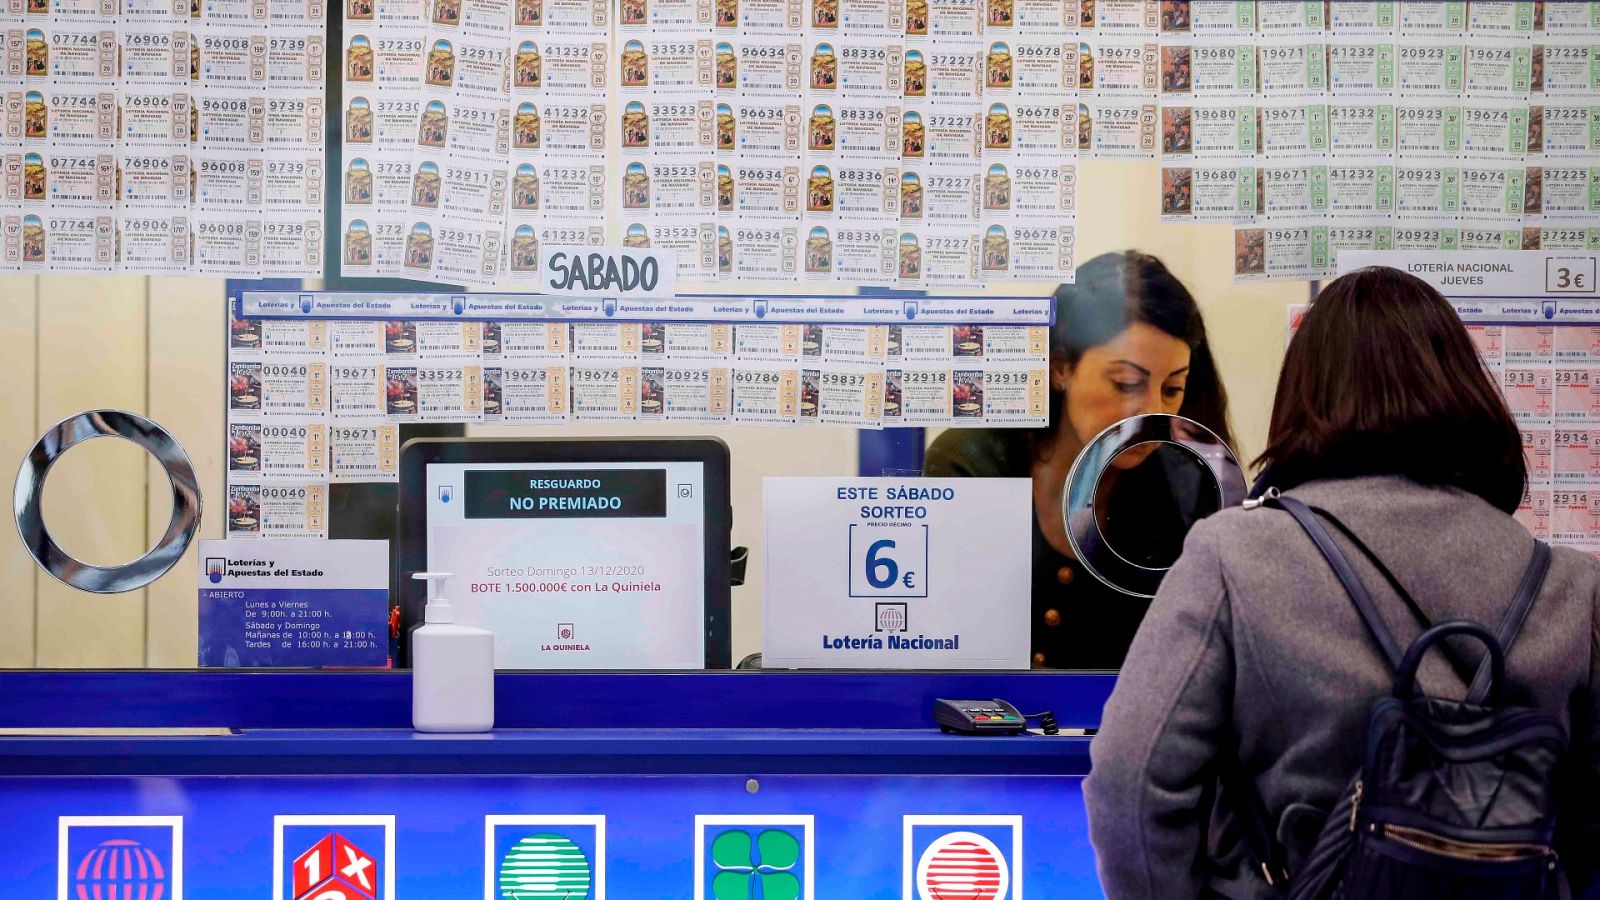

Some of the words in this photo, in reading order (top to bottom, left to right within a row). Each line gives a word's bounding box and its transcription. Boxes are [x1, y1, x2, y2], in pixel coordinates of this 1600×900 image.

[52, 34, 98, 46] 07744
[124, 34, 170, 46] 76906
[204, 38, 249, 50] 96008
[378, 40, 422, 50] 37230
[460, 46, 503, 59] 32911
[545, 46, 589, 57] 41232
[652, 44, 695, 54] 33523
[742, 47, 785, 58] 96634
[842, 48, 886, 58] 88336
[1018, 46, 1061, 56] 96678
[1098, 46, 1140, 58] 19679
[1194, 48, 1236, 59] 19680
[1262, 48, 1304, 58] 19671
[1331, 46, 1375, 58] 41232
[1400, 48, 1444, 58] 20923
[1469, 49, 1512, 60] 19674
[1545, 48, 1588, 58] 37225
[931, 55, 974, 66] 37227
[1096, 108, 1139, 119] 19679
[50, 158, 96, 168] 07744
[124, 158, 168, 168] 76906
[201, 162, 246, 172] 96008
[446, 168, 489, 182] 32911
[542, 168, 586, 180] 41232
[654, 166, 696, 177] 33523
[738, 169, 782, 180] 96634
[839, 170, 882, 181] 88336
[1016, 168, 1058, 178] 96678
[1194, 170, 1237, 180] 19680
[1266, 170, 1308, 180] 19671
[1330, 170, 1374, 180] 41232
[1398, 170, 1442, 180] 20923
[1464, 171, 1505, 182] 19674
[1544, 170, 1586, 180] 37225
[928, 178, 971, 188] 37227
[548, 252, 658, 292] SABADO
[1457, 264, 1513, 272] NACIONAL
[263, 366, 308, 376] 00040
[334, 368, 377, 378] 19671
[418, 370, 463, 380] 33522
[504, 371, 547, 382] 19673
[576, 370, 620, 382] 19674
[666, 371, 709, 382] 20925
[736, 372, 780, 383] 60786
[822, 374, 866, 386] 59837
[903, 372, 946, 383] 32918
[986, 372, 1028, 383] 32919
[262, 427, 307, 438] 00040
[336, 428, 378, 438] 19671
[530, 480, 600, 488] RESGUARDO
[262, 488, 306, 498] 00040
[838, 488, 878, 499] ESTE
[887, 485, 954, 500] SÁBADO
[510, 498, 534, 510] NO
[540, 497, 621, 509] PREMIADO
[861, 506, 926, 518] SORTEO
[488, 567, 524, 576] Sorteo
[528, 567, 577, 578] Domingo
[582, 566, 644, 575] 13/12/2020
[472, 584, 501, 592] BOTE
[506, 583, 567, 592] 1.500.000€
[596, 583, 608, 591] La
[612, 582, 660, 593] Quiniela
[285, 622, 320, 630] Domingo
[824, 635, 882, 649] Lotería
[888, 634, 958, 649] Nacional
